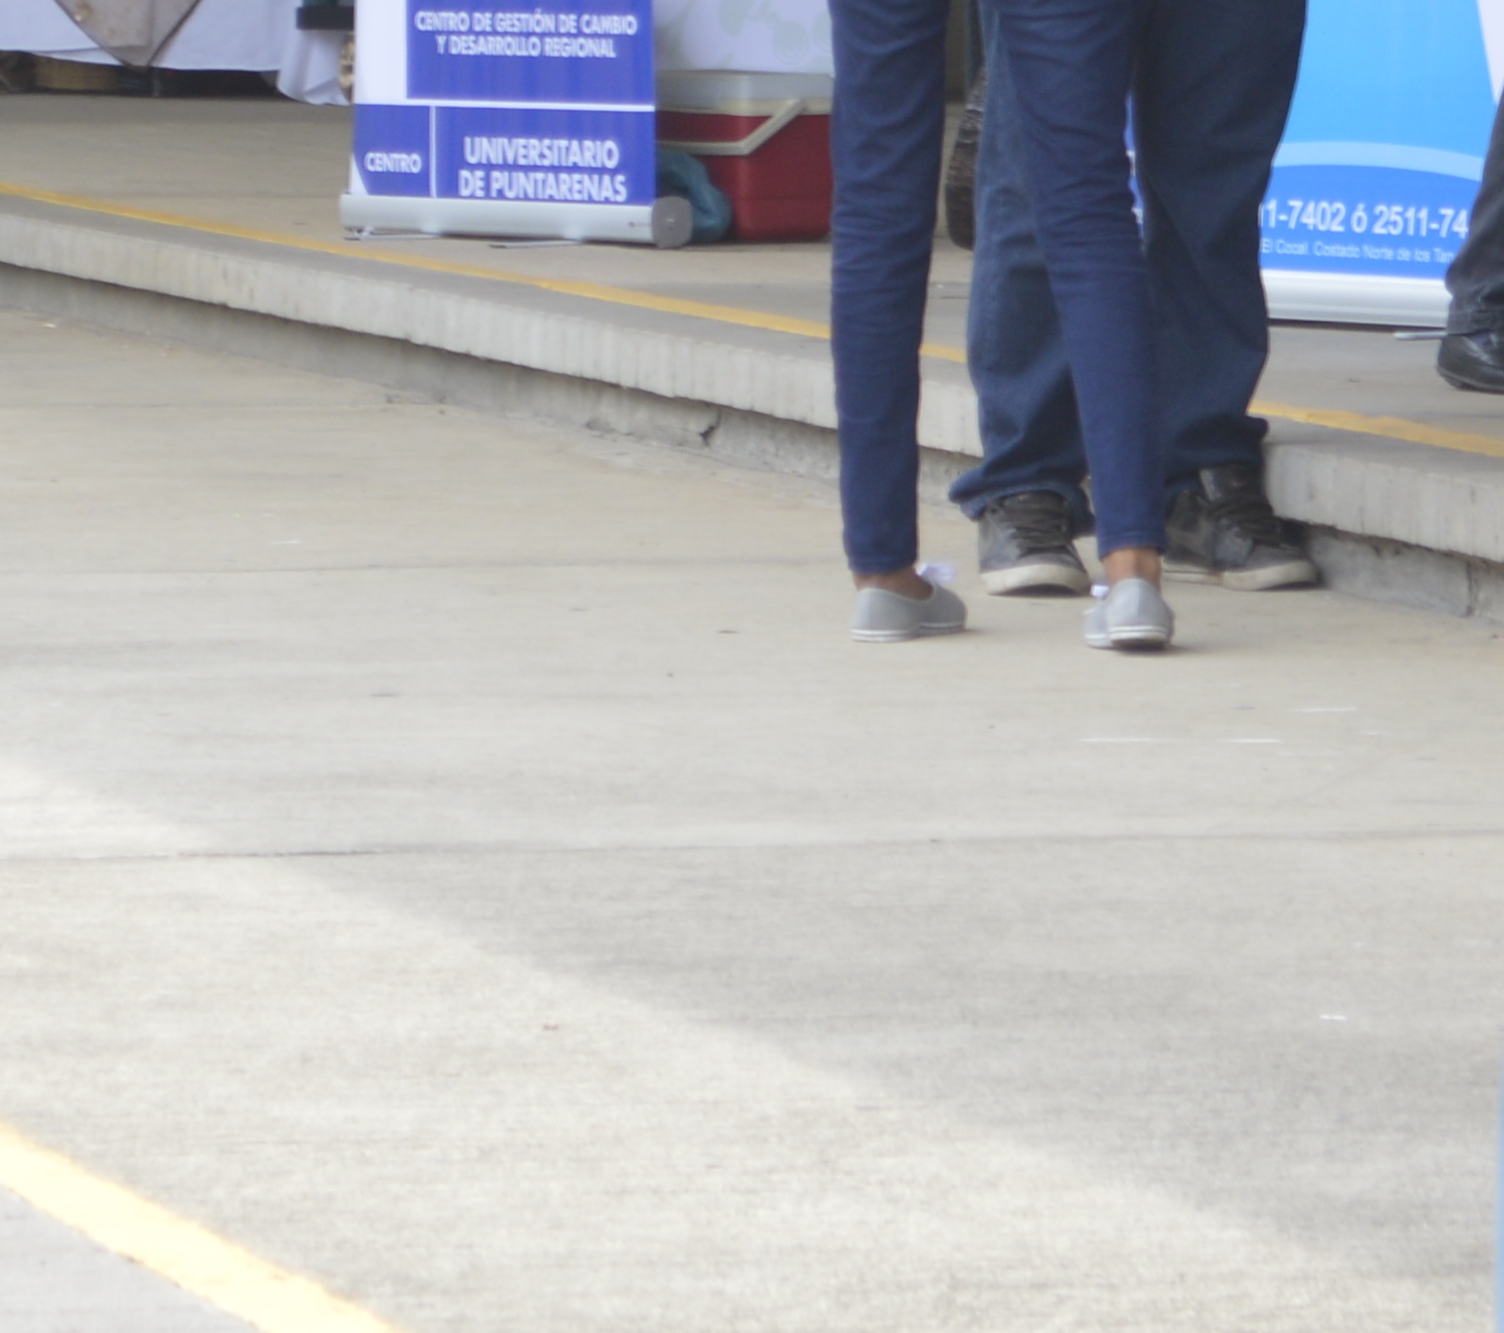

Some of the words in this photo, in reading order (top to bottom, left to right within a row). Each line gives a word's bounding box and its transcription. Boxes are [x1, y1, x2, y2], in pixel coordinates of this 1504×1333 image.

[414, 11, 470, 31] CENTRO
[472, 12, 493, 32] DE
[494, 8, 556, 33] GESTIÓN
[558, 13, 577, 33] DE
[580, 14, 638, 35] CAMBIO
[435, 34, 447, 54] Y
[449, 35, 542, 56] DESARROLLO
[544, 36, 617, 58] REGIONAL
[364, 152, 422, 173] CENTRO
[463, 136, 619, 169] UNIVERSITARIO
[458, 170, 486, 197] DE
[490, 171, 627, 203] PUNTARENAS
[1372, 204, 1469, 239] 2511-74
[1314, 241, 1361, 259] Costado
[1363, 245, 1394, 261] Norte
[1397, 247, 1411, 262] de
[1415, 248, 1430, 263] los
